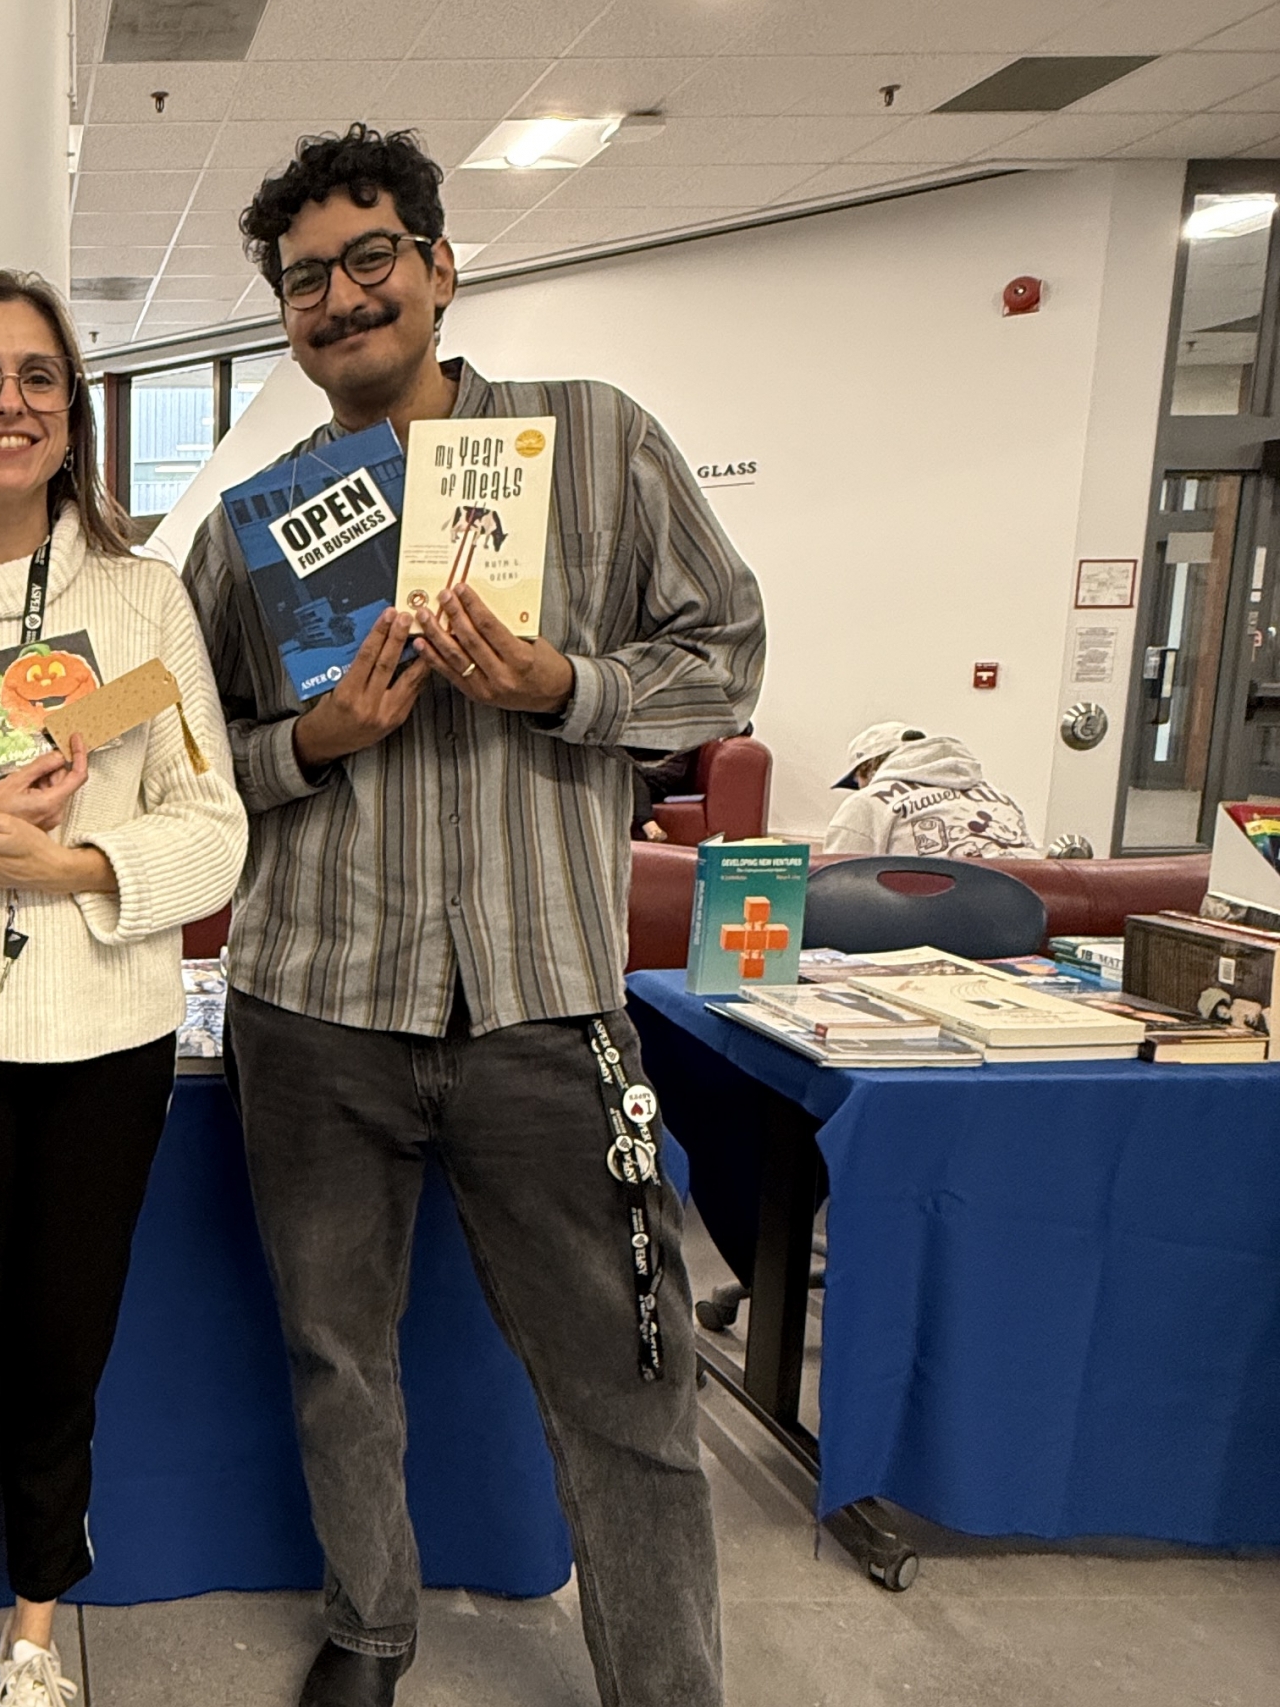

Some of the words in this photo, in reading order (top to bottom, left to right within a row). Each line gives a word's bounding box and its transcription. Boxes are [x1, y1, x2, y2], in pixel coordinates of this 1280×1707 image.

[697, 461, 757, 479] GLASS
[440, 473, 457, 497] of
[281, 476, 378, 552] OPEN
[298, 545, 325, 570] FOR
[324, 509, 387, 559] BUSINESS
[29, 583, 42, 614] ASPER
[300, 672, 328, 691] ASPER
[892, 789, 962, 818] Travel
[644, 1099, 654, 1116] I
[635, 1248, 649, 1276] ASPER
